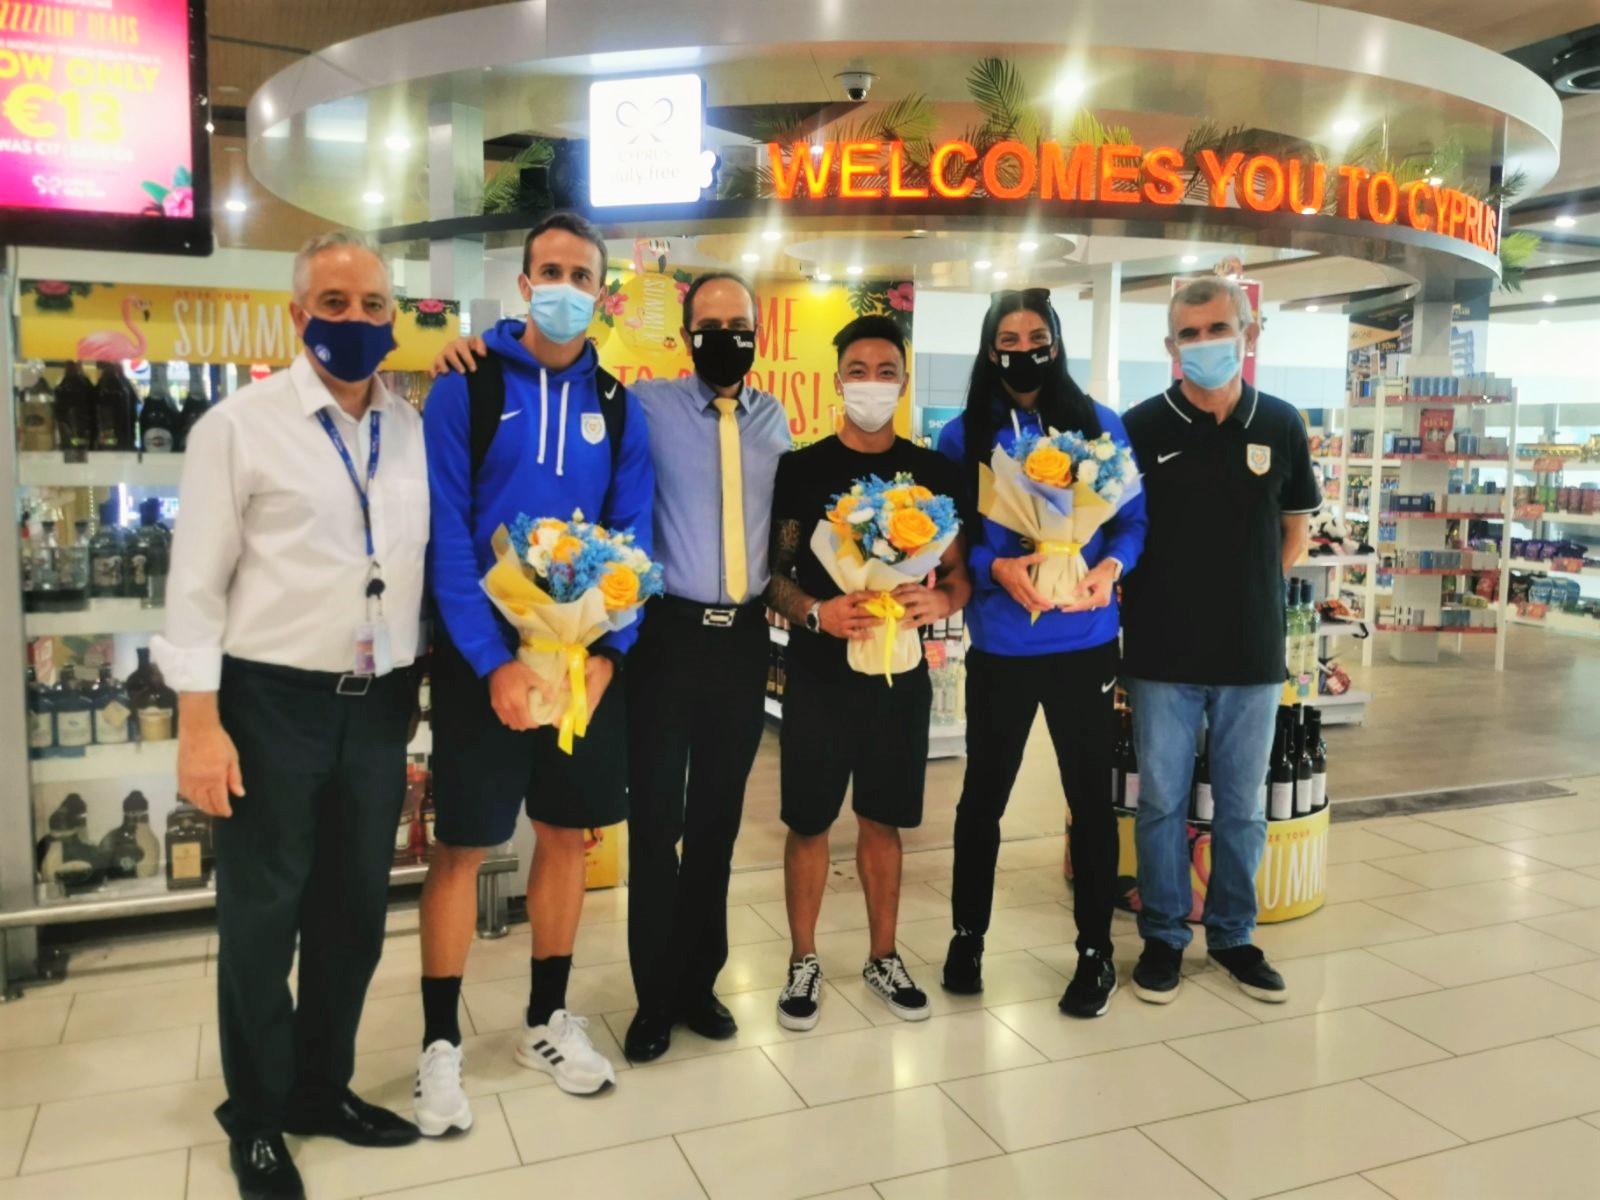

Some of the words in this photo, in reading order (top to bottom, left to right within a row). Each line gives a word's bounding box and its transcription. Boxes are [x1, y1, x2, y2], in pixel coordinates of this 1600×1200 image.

[66, 58, 160, 92] ONLY
[4, 83, 123, 143] €13
[767, 140, 1186, 205] WELCOMES
[1198, 150, 1326, 214] YOU
[1337, 165, 1398, 225] TO
[1406, 179, 1498, 255] CYPRUS
